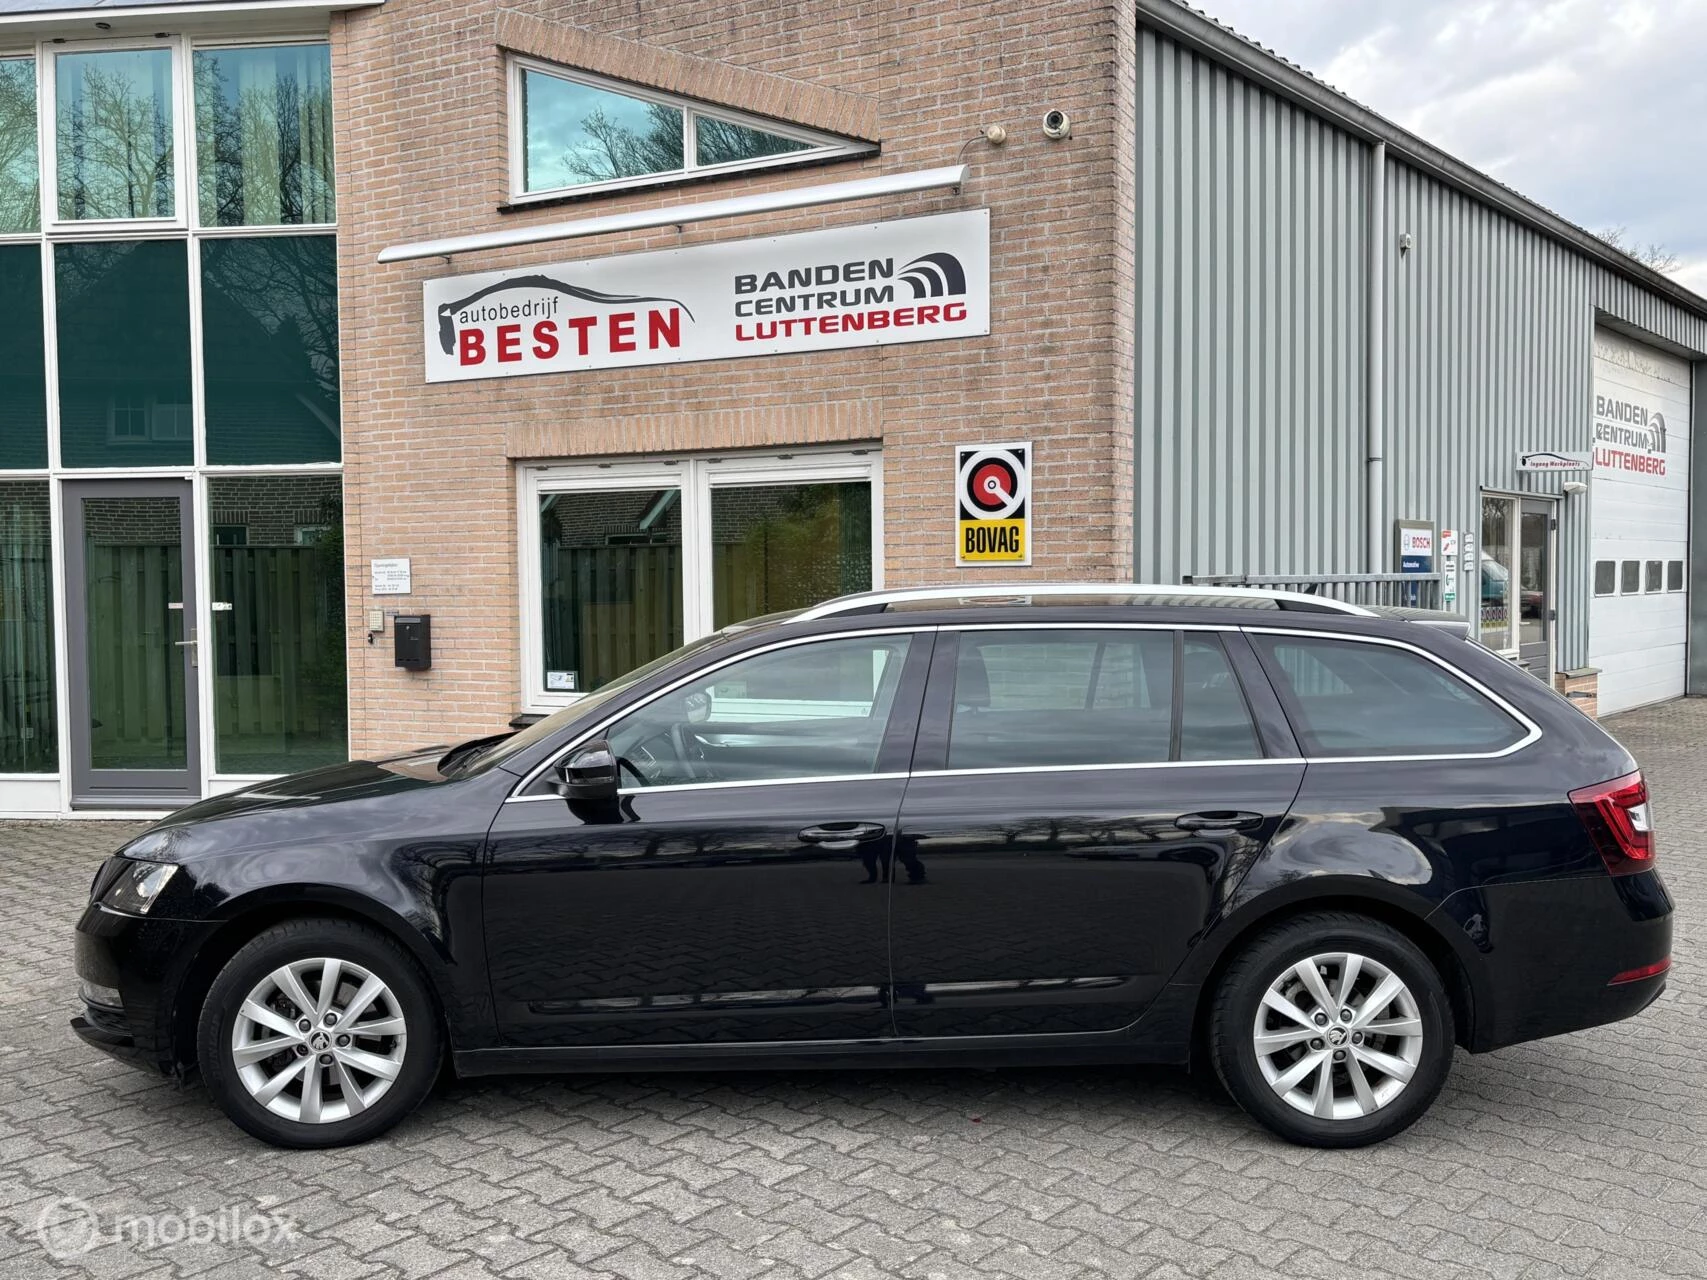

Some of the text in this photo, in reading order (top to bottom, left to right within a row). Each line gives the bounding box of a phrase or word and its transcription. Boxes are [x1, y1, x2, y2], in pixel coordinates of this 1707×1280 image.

[734, 257, 893, 294] BANDEN
[459, 297, 559, 324] autobedrijf
[734, 285, 894, 317] CENTRUM
[735, 302, 967, 341] LUTTENBERG
[459, 308, 681, 366] BESTEN
[1596, 395, 1649, 427] BANDEN
[1596, 422, 1650, 448] CENTRUM
[1595, 447, 1666, 476] LUTTENBERG
[965, 526, 1020, 554] BOVAG
[1411, 536, 1431, 549] BOSCH
